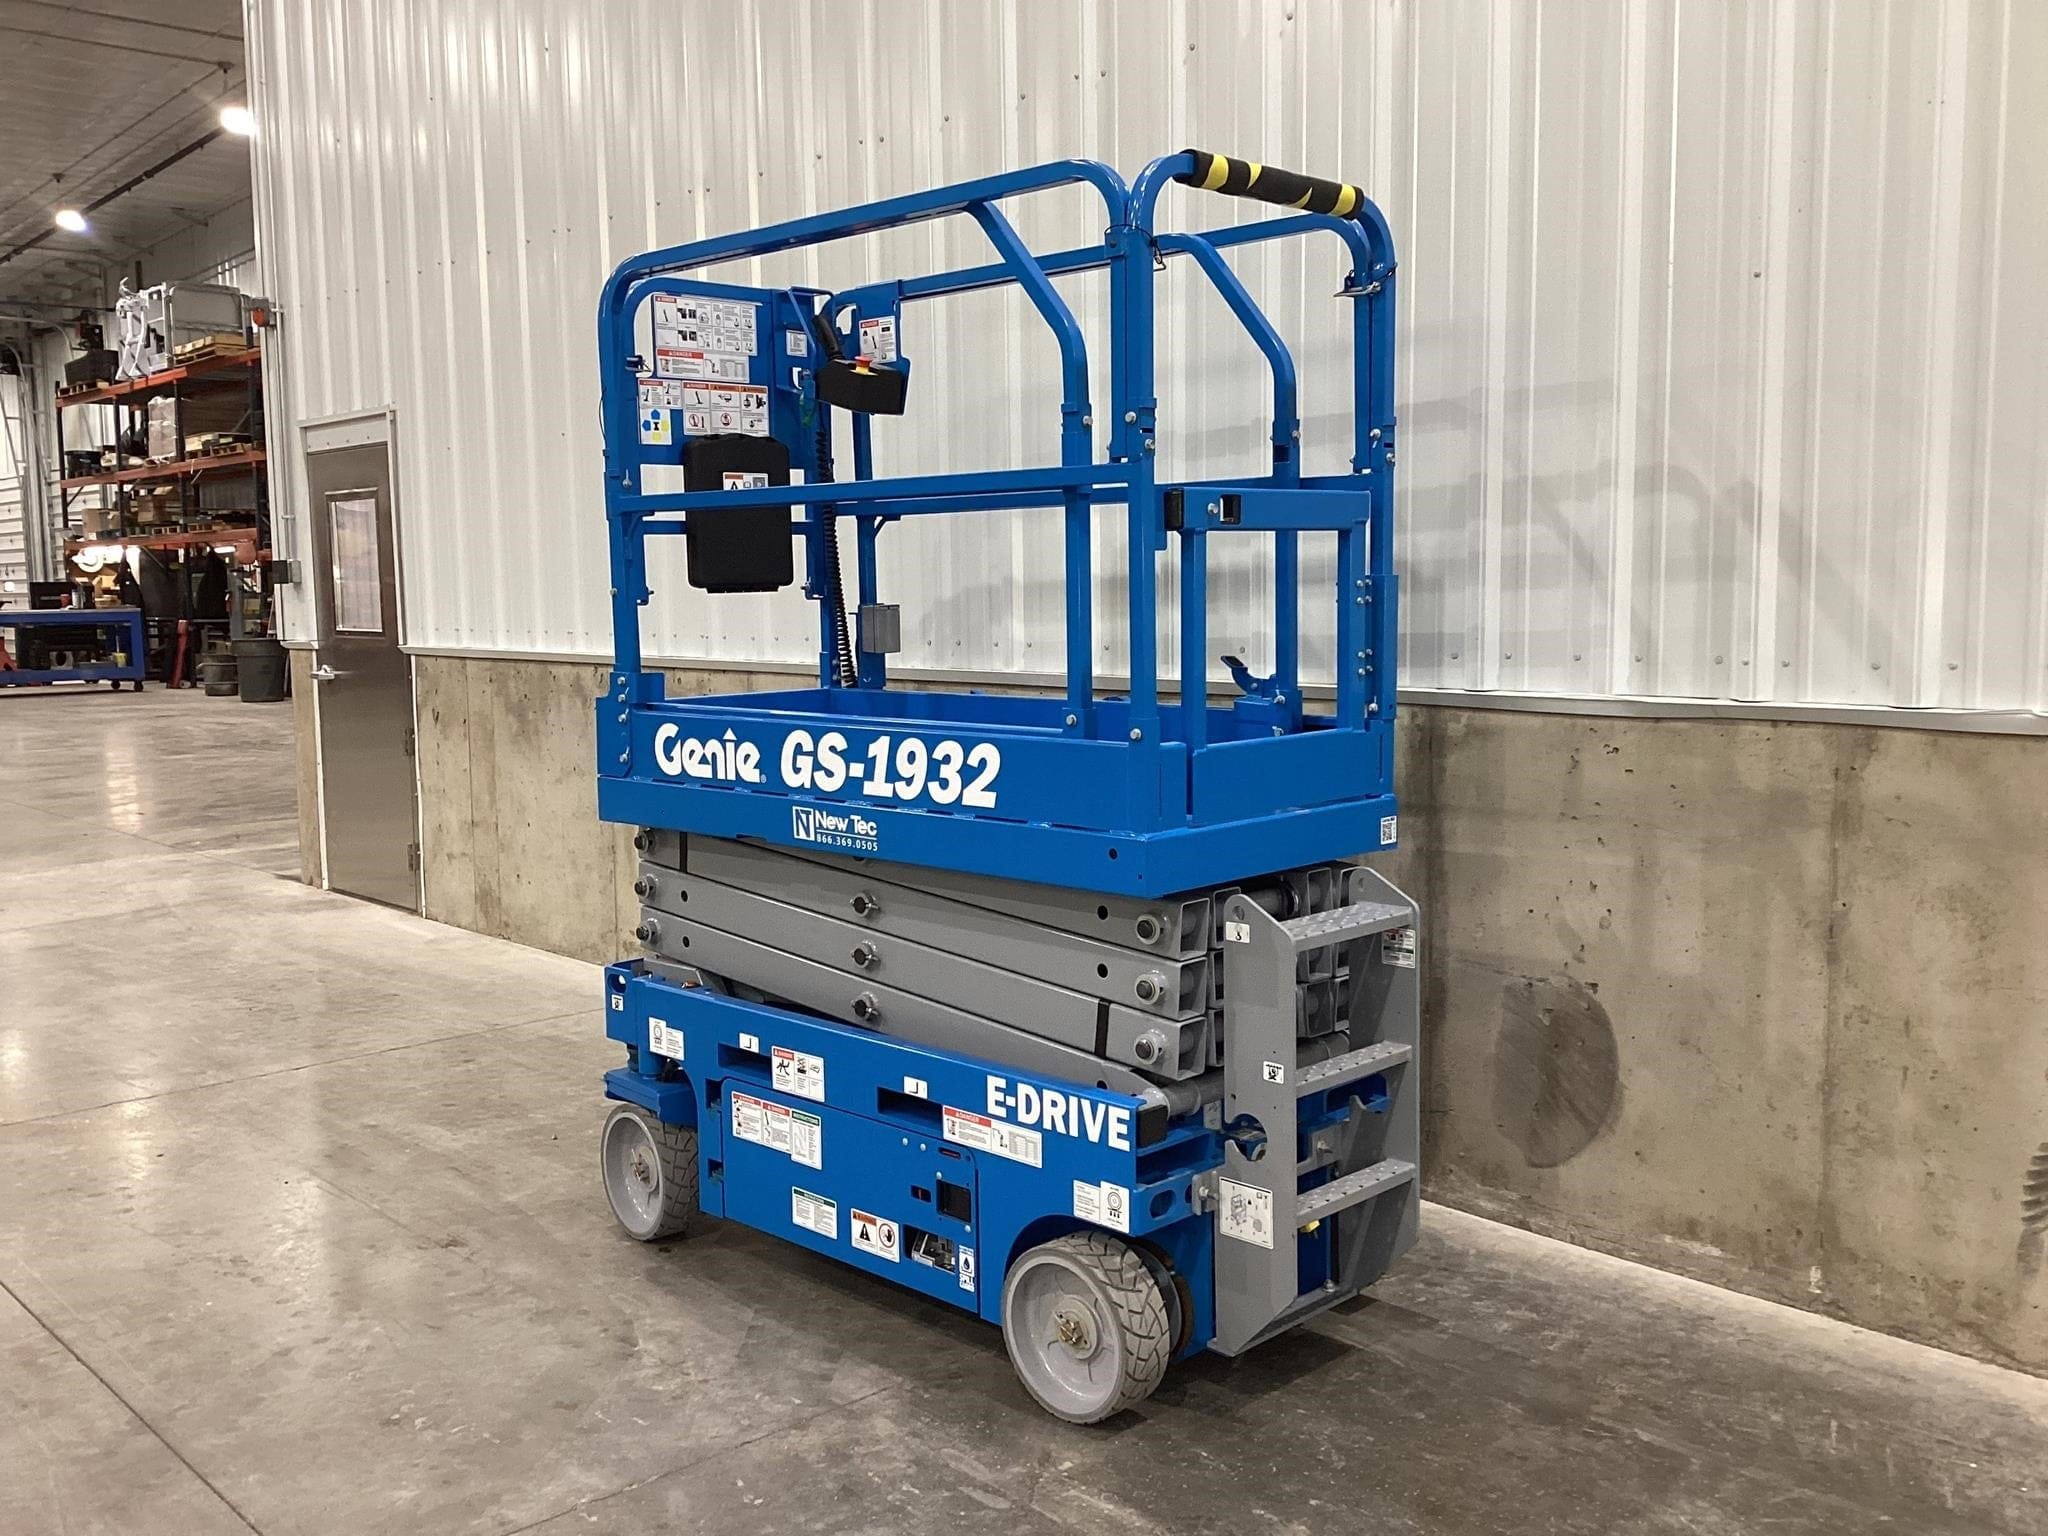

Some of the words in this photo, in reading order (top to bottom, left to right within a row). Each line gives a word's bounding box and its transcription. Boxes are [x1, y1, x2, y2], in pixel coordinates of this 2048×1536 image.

[654, 722, 761, 783] Genie
[780, 729, 1001, 809] GS-1932
[815, 810, 849, 832] New
[850, 814, 877, 836] Tec
[816, 833, 878, 852] 866.369.0505
[986, 1074, 1131, 1152] E-DRIVE
